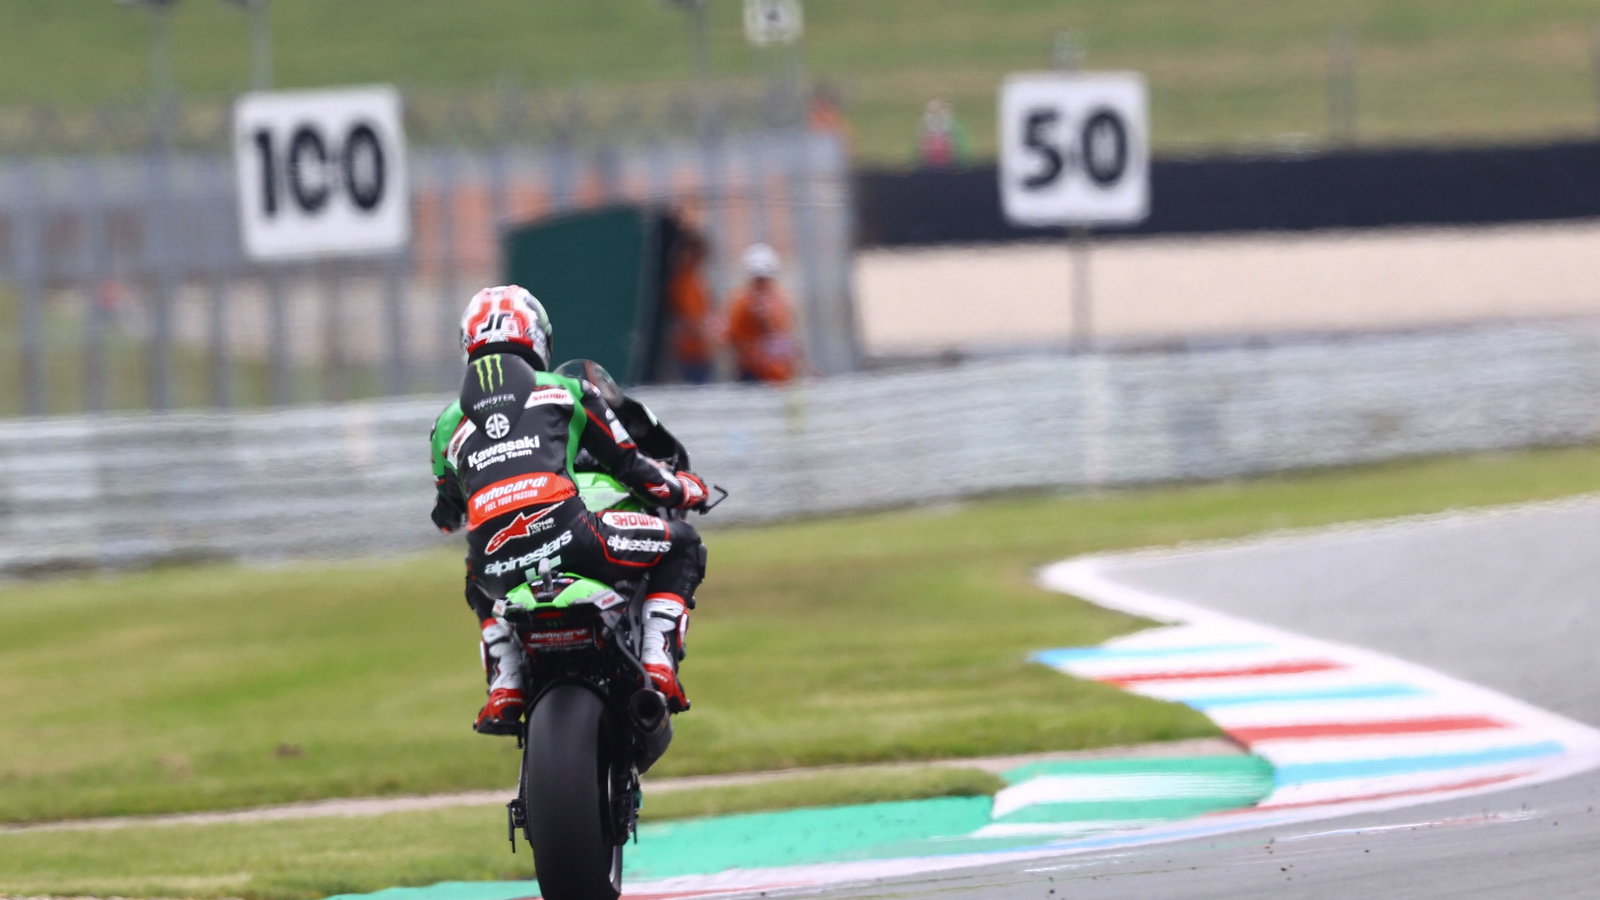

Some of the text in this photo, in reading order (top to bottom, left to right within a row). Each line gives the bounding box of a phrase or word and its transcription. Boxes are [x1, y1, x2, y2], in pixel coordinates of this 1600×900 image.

[1021, 106, 1130, 191] 50
[252, 121, 387, 218] 100
[467, 435, 540, 468] Kawasaki
[476, 449, 533, 471] Racing Team
[484, 489, 539, 513] FUEL YOUR PASSION
[612, 514, 658, 528] SHOWA
[484, 529, 573, 577] alpinestars
[606, 534, 673, 553] alpinestars
